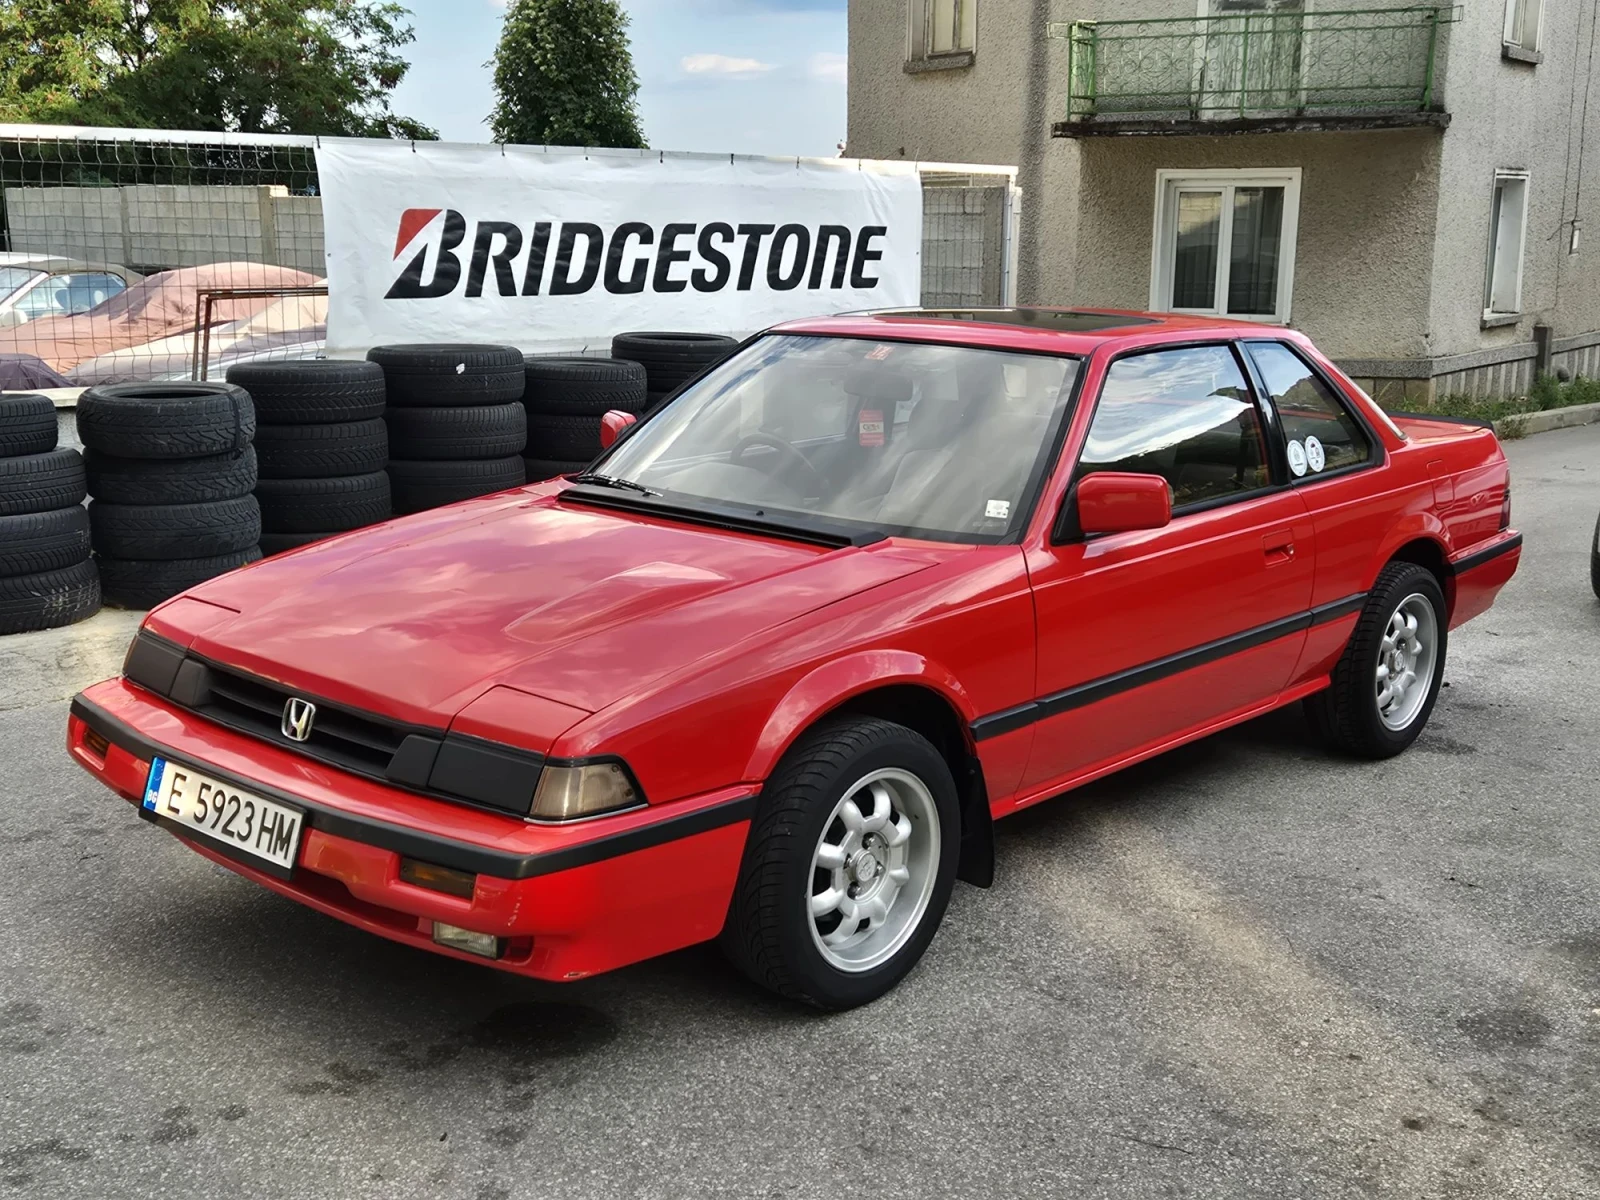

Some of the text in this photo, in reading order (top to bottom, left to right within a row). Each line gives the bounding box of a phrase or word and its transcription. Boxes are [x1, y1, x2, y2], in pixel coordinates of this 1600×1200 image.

[384, 208, 887, 299] BRIDGESTONE
[147, 791, 158, 804] BG
[167, 772, 296, 860] E 5923 HM
